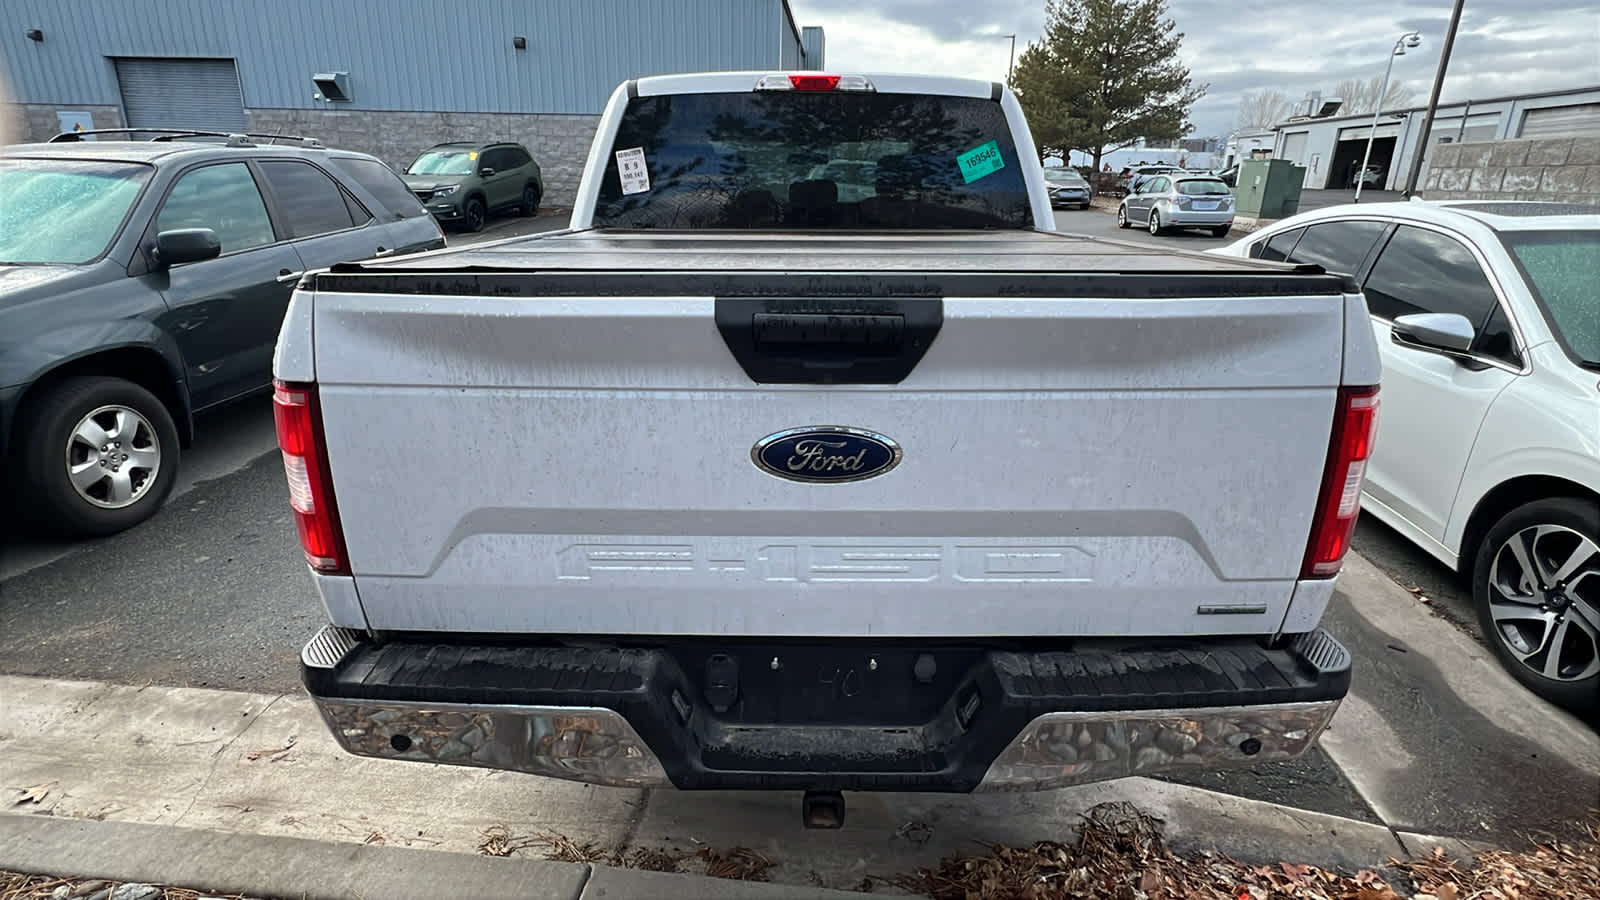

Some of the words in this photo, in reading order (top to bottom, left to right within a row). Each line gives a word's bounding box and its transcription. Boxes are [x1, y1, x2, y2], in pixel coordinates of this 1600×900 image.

[965, 146, 996, 168] 169546
[787, 439, 868, 471] Ford
[557, 543, 1096, 582] F-150
